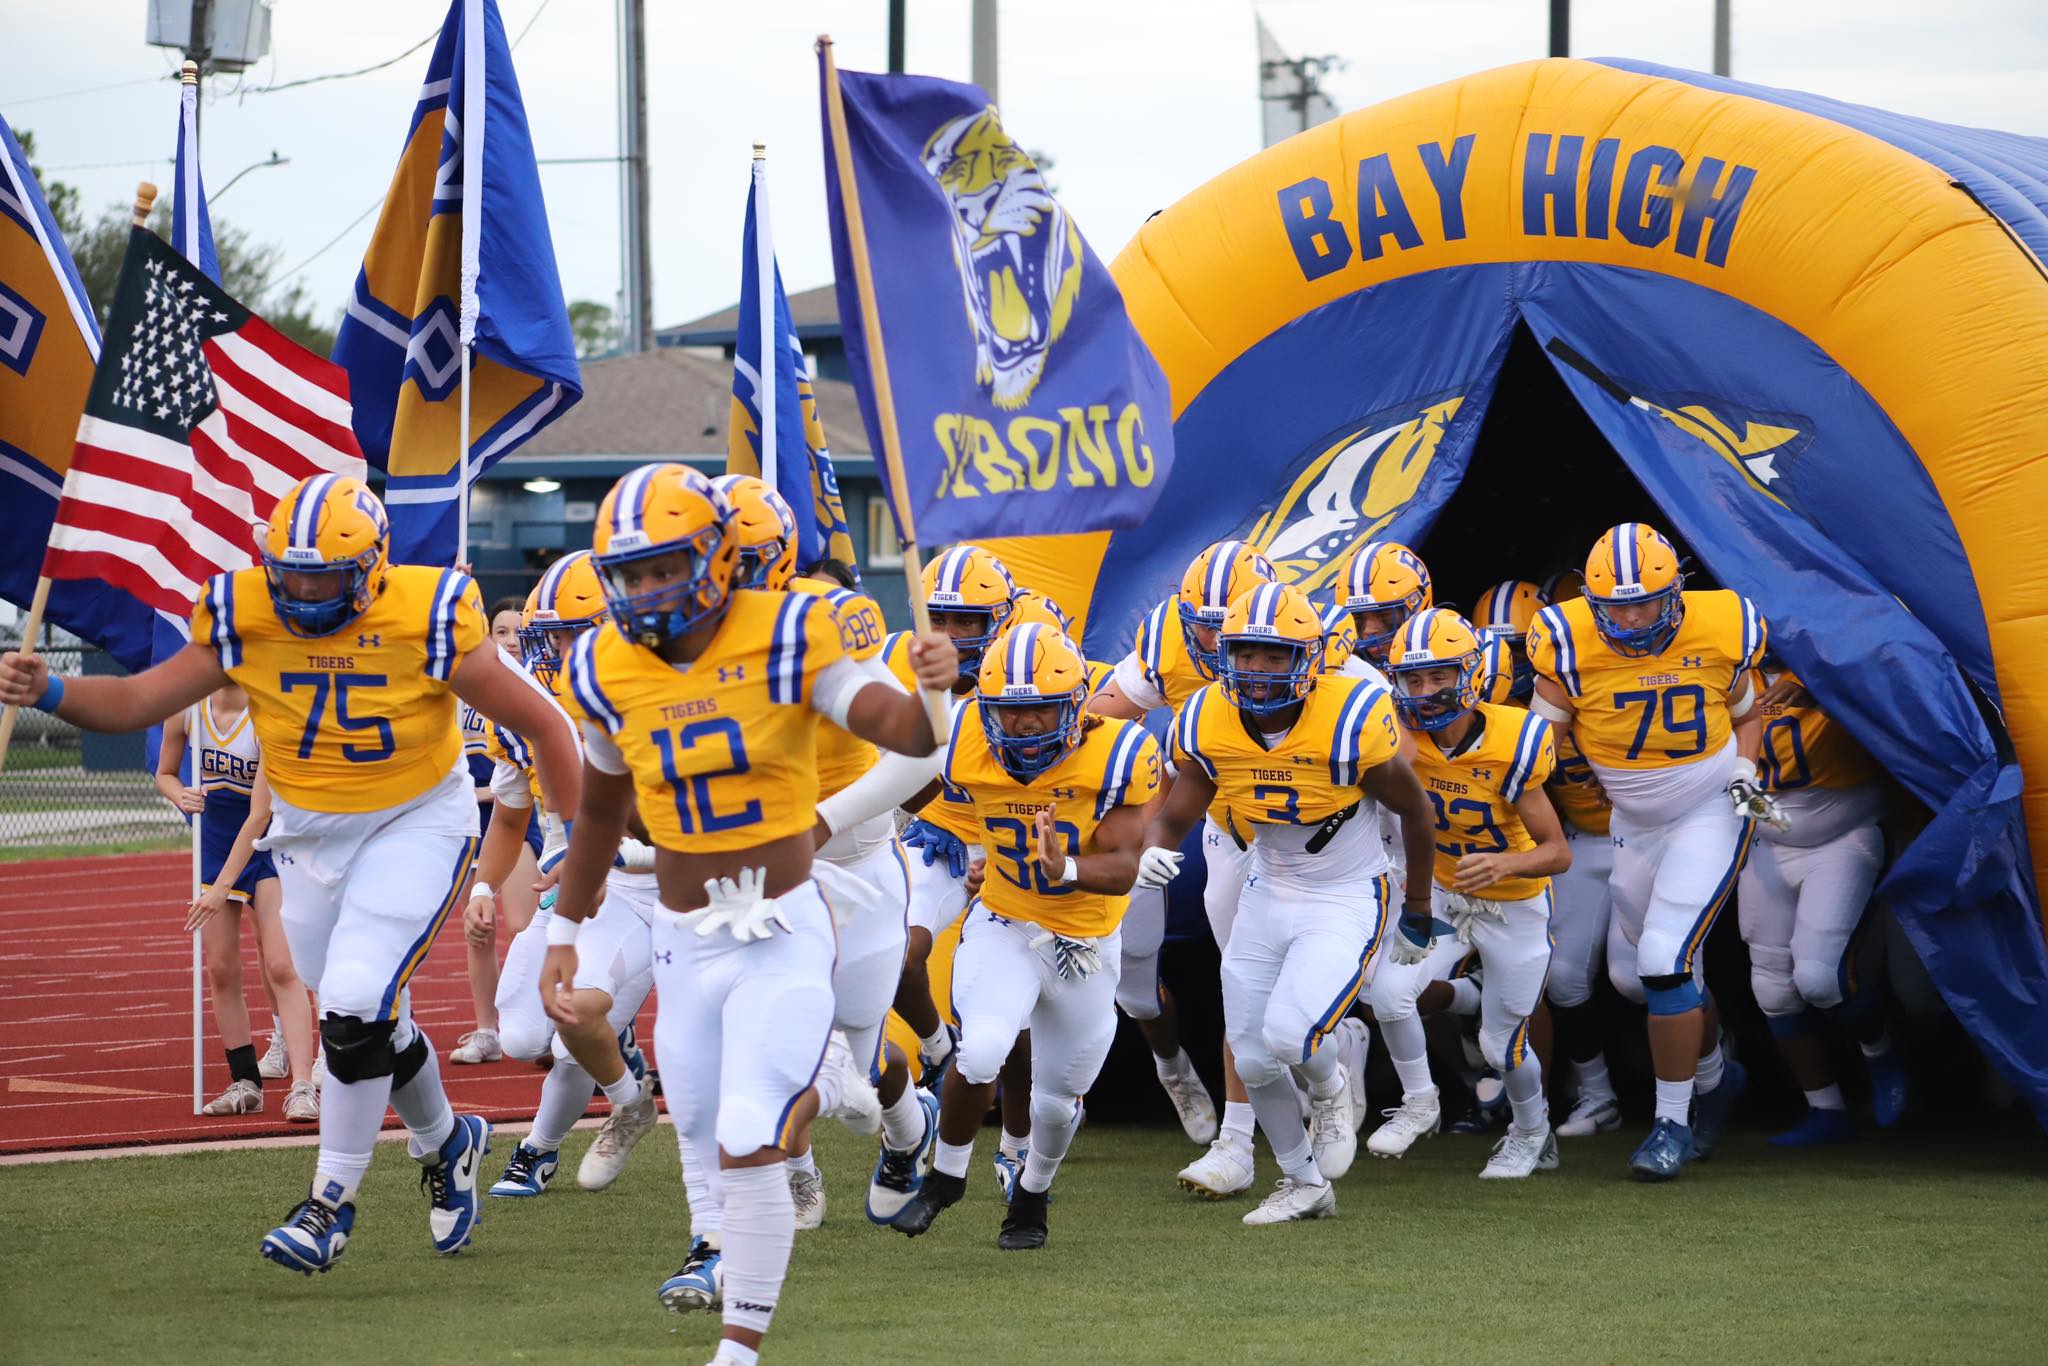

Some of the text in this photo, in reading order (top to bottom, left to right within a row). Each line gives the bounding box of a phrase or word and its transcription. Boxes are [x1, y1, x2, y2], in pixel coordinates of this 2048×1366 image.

[1277, 133, 1758, 282] BAY HIGH
[288, 550, 314, 560] TIGERS
[933, 593, 958, 602] TIGERS
[1616, 587, 1640, 596] TIGERS
[1347, 596, 1369, 604] TIGERS
[1201, 610, 1224, 618] TIGERS
[846, 608, 880, 650] 88
[1247, 626, 1273, 634] TIGERS
[307, 656, 354, 669] TIGERS
[1404, 651, 1428, 661] TIGERS
[1638, 674, 1680, 687] TIGERS
[1006, 687, 1033, 696] TIGERS
[660, 698, 717, 721] TIGERS
[280, 672, 396, 763] 75
[1613, 684, 1706, 760] 79
[1382, 713, 1397, 747] 3
[1759, 716, 1812, 789] 0
[201, 748, 259, 780] GERS
[650, 717, 763, 834] 12
[1251, 769, 1293, 782] TIGERS
[1429, 777, 1468, 795] TIGERS
[1254, 785, 1302, 825] 3
